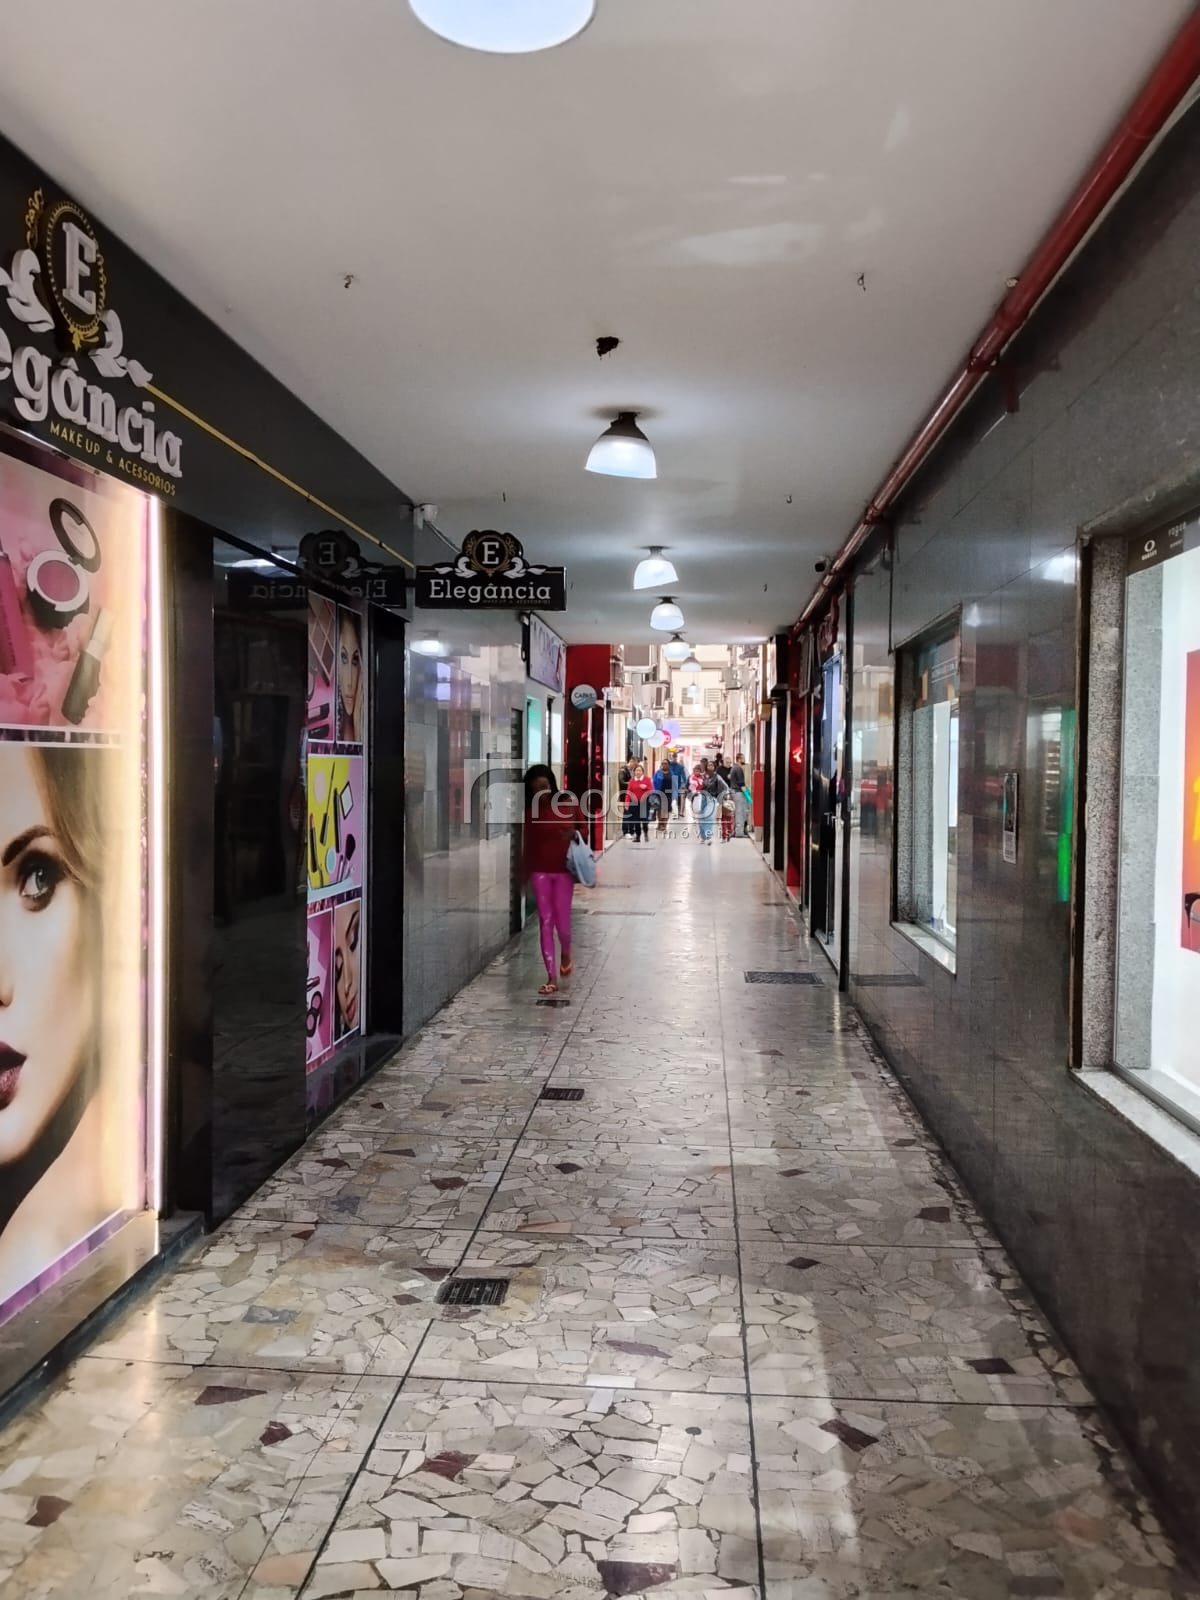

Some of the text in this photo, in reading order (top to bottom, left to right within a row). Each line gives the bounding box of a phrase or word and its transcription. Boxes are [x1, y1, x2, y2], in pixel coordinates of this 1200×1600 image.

[62, 221, 97, 316] E
[50, 421, 176, 496] MAKE UP & ACESSORIOS
[482, 541, 500, 565] E
[429, 579, 551, 603] Elegância
